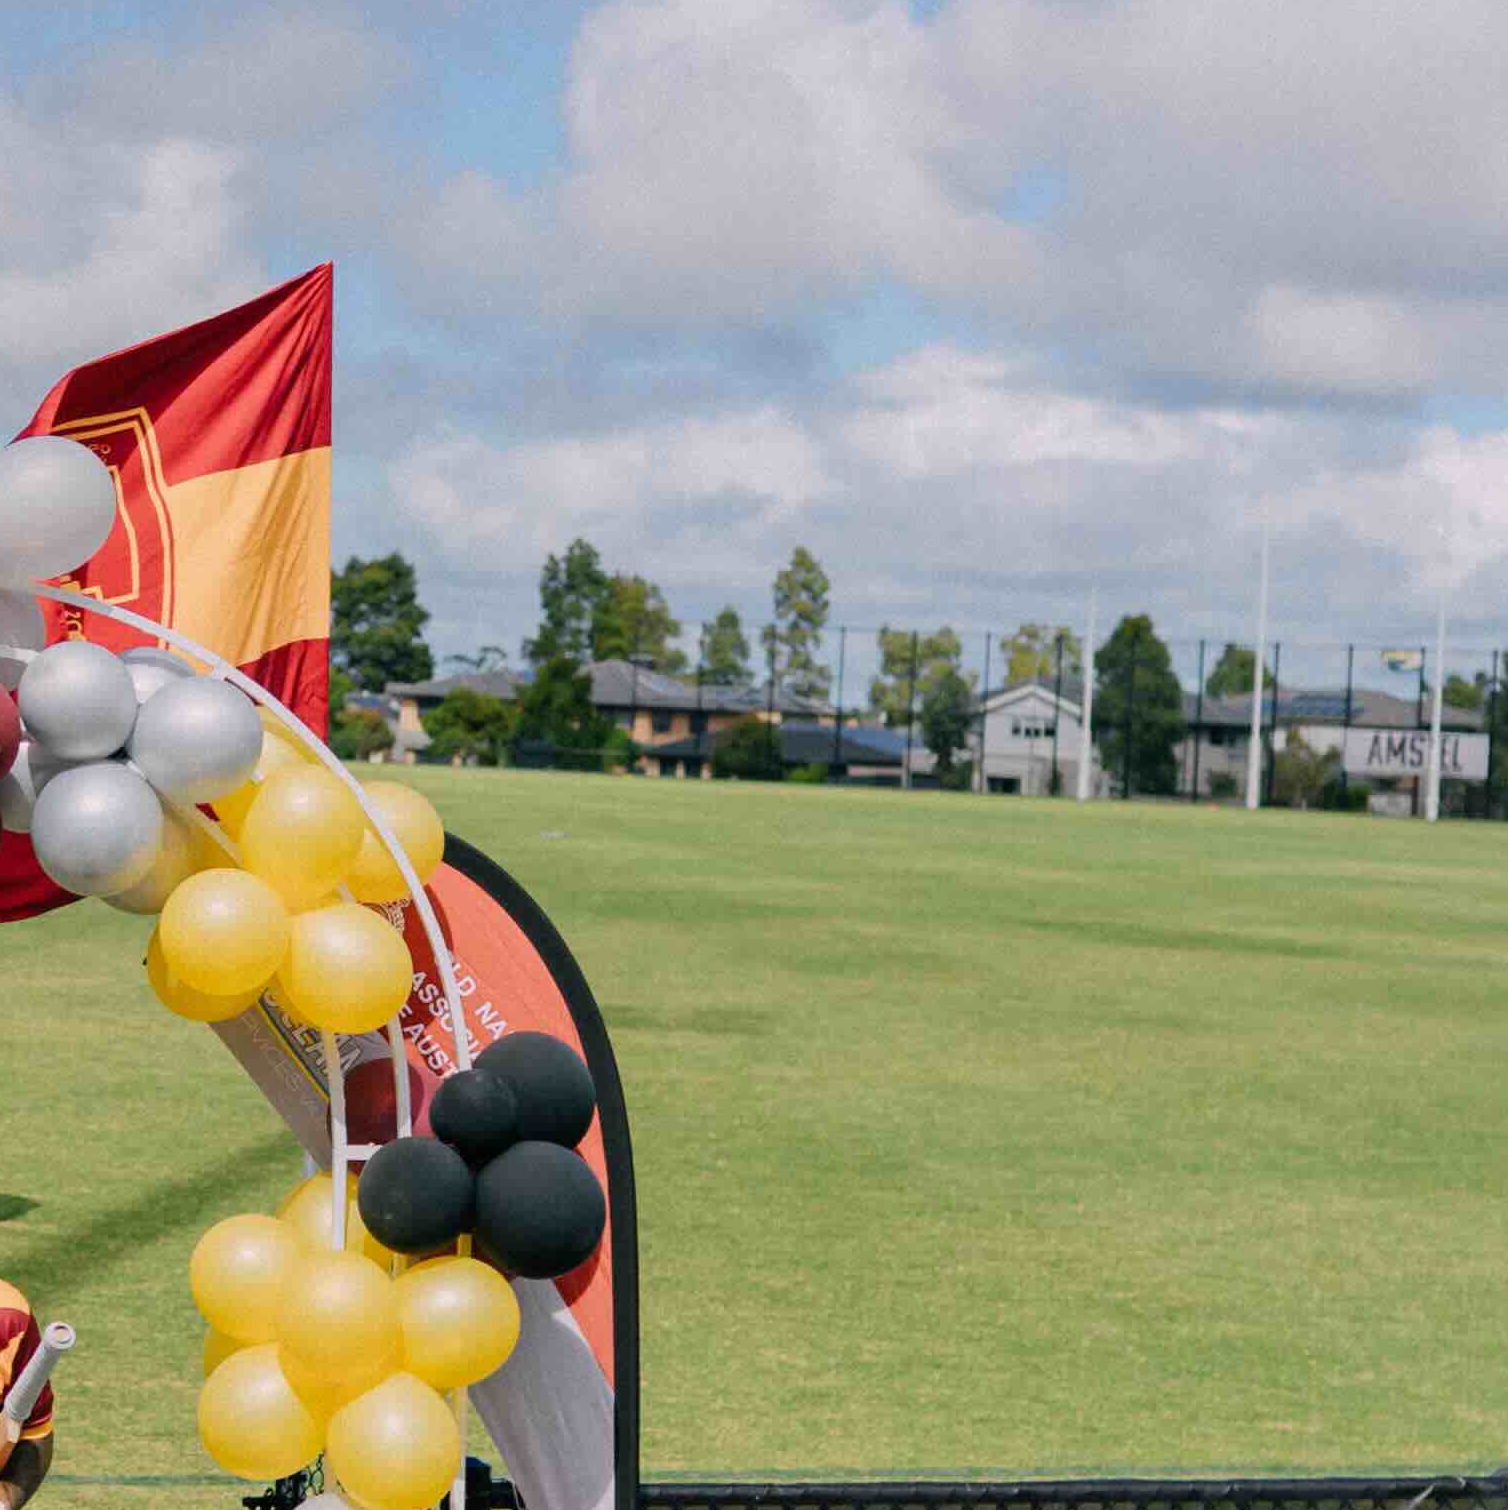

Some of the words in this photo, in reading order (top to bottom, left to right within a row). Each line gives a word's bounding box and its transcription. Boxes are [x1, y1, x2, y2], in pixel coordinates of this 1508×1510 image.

[1367, 733, 1462, 772] AMSEL
[450, 959, 477, 998] LD
[403, 1022, 460, 1081] AUST
